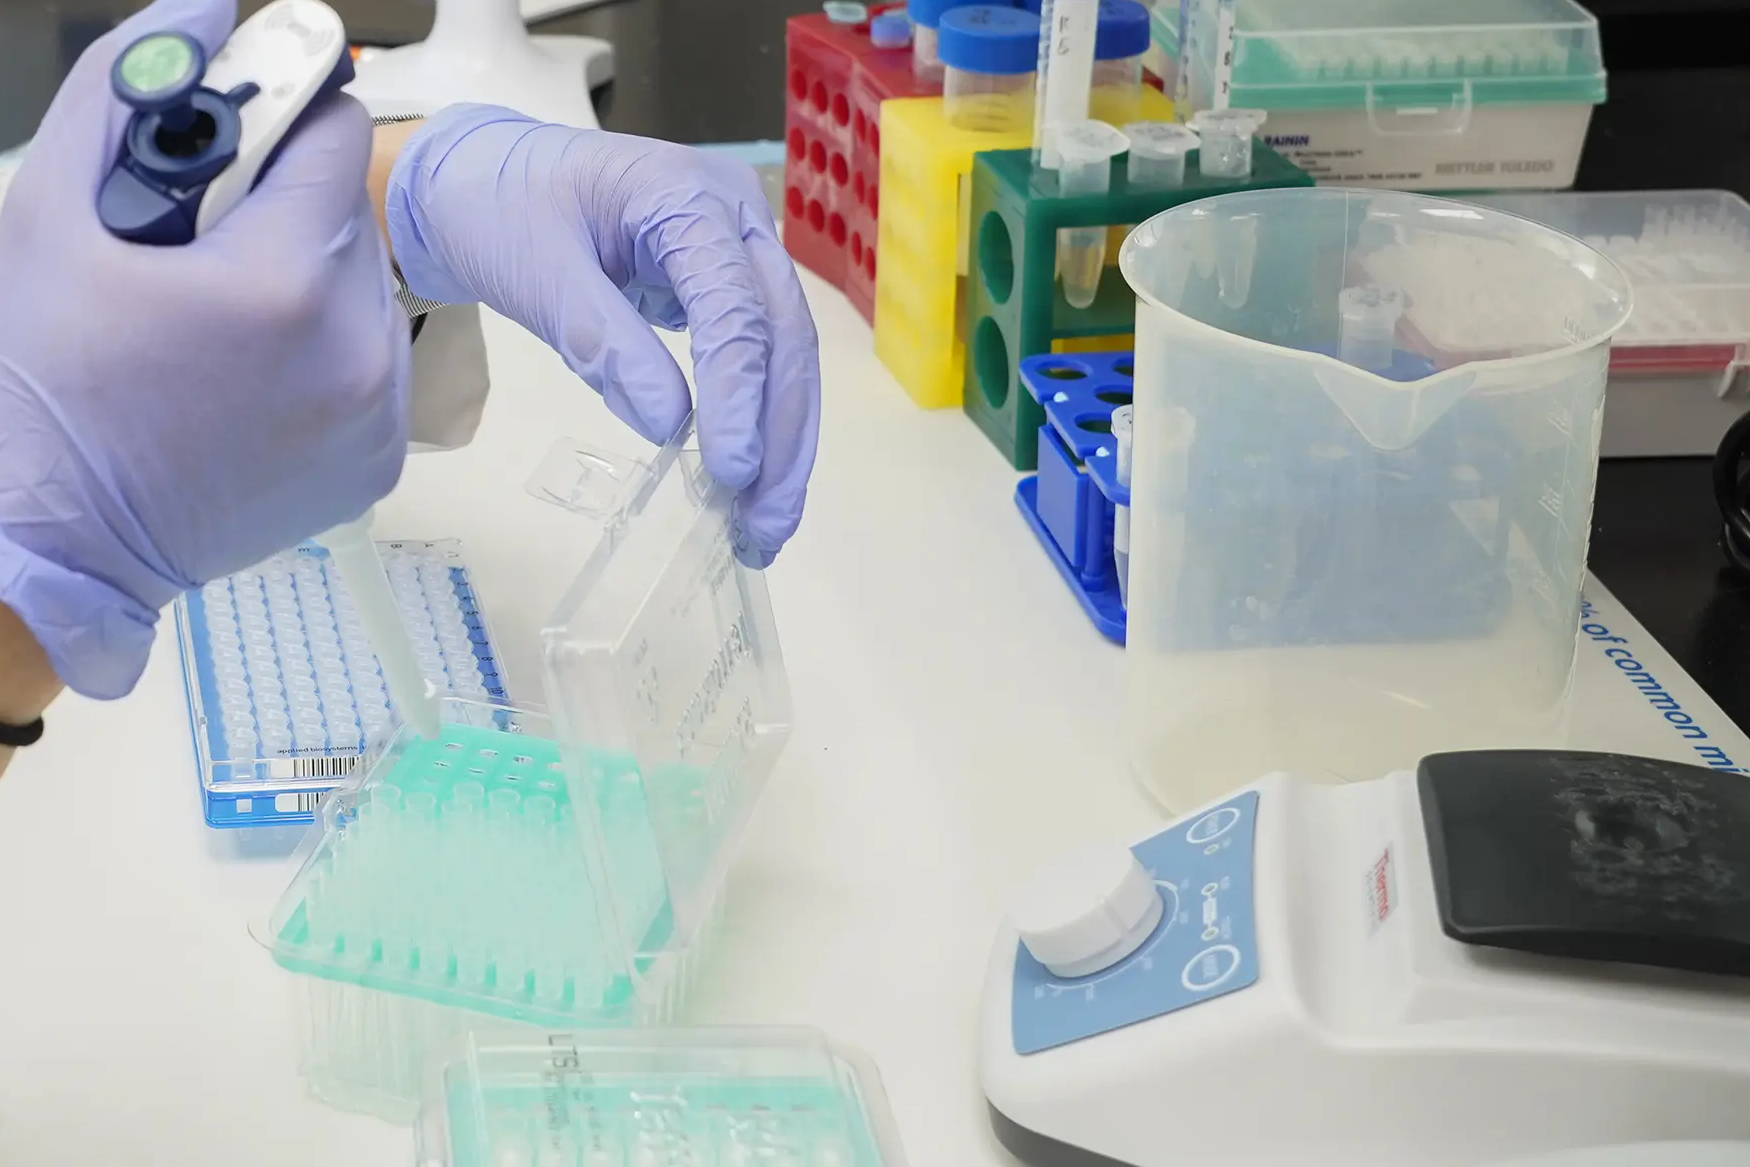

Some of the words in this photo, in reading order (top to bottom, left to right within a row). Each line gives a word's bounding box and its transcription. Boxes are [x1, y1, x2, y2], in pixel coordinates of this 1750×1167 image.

[1581, 623, 1629, 645] of
[1604, 648, 1708, 739] common
[277, 745, 309, 755] applied
[310, 744, 359, 753] biosystems
